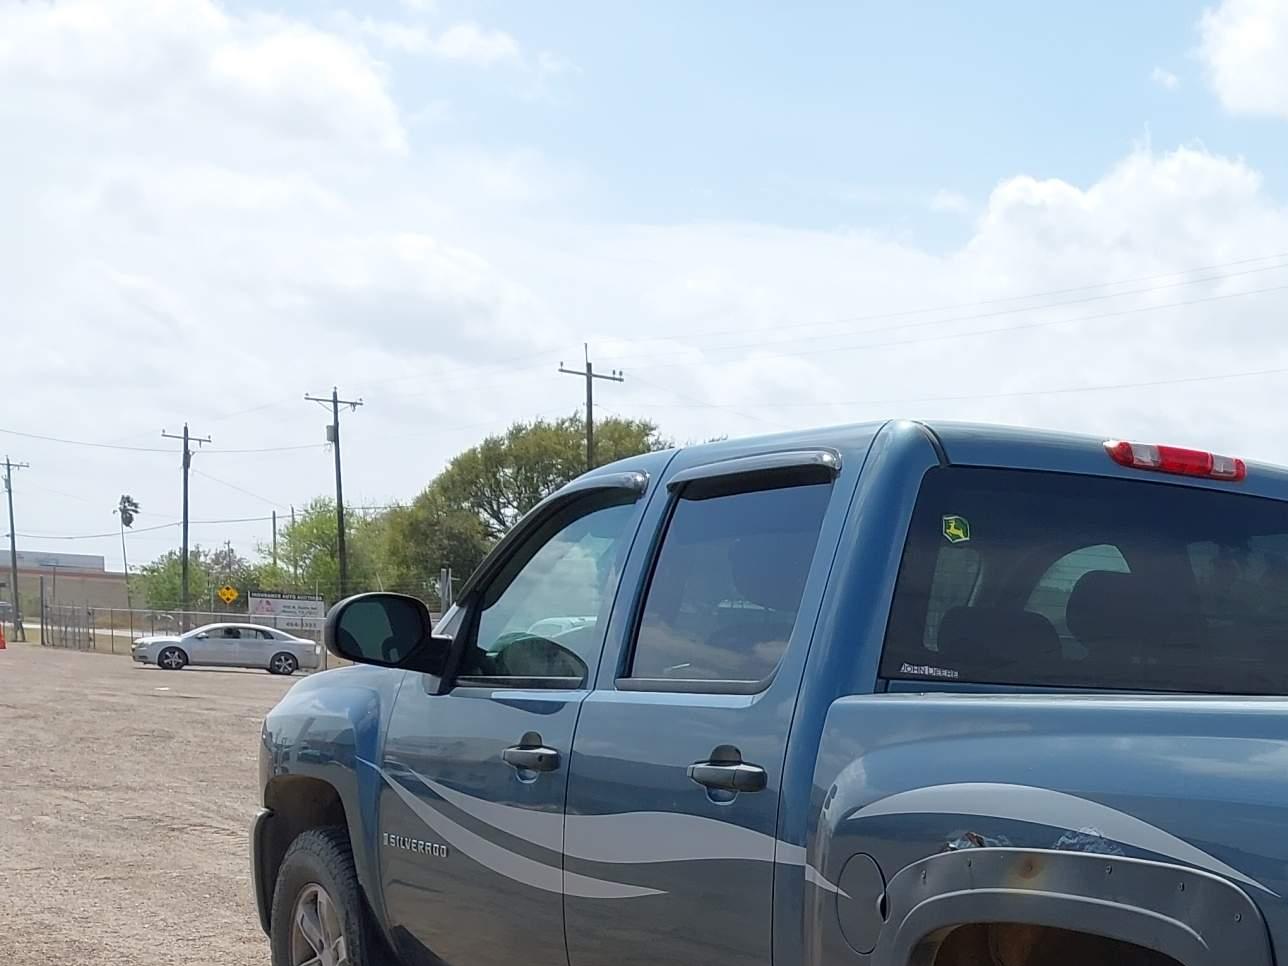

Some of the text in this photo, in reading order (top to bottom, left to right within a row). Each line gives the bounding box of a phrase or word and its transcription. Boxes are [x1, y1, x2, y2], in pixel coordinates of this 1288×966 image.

[900, 662, 959, 678] JOHN DEERE
[389, 833, 447, 858] SILVERADO
